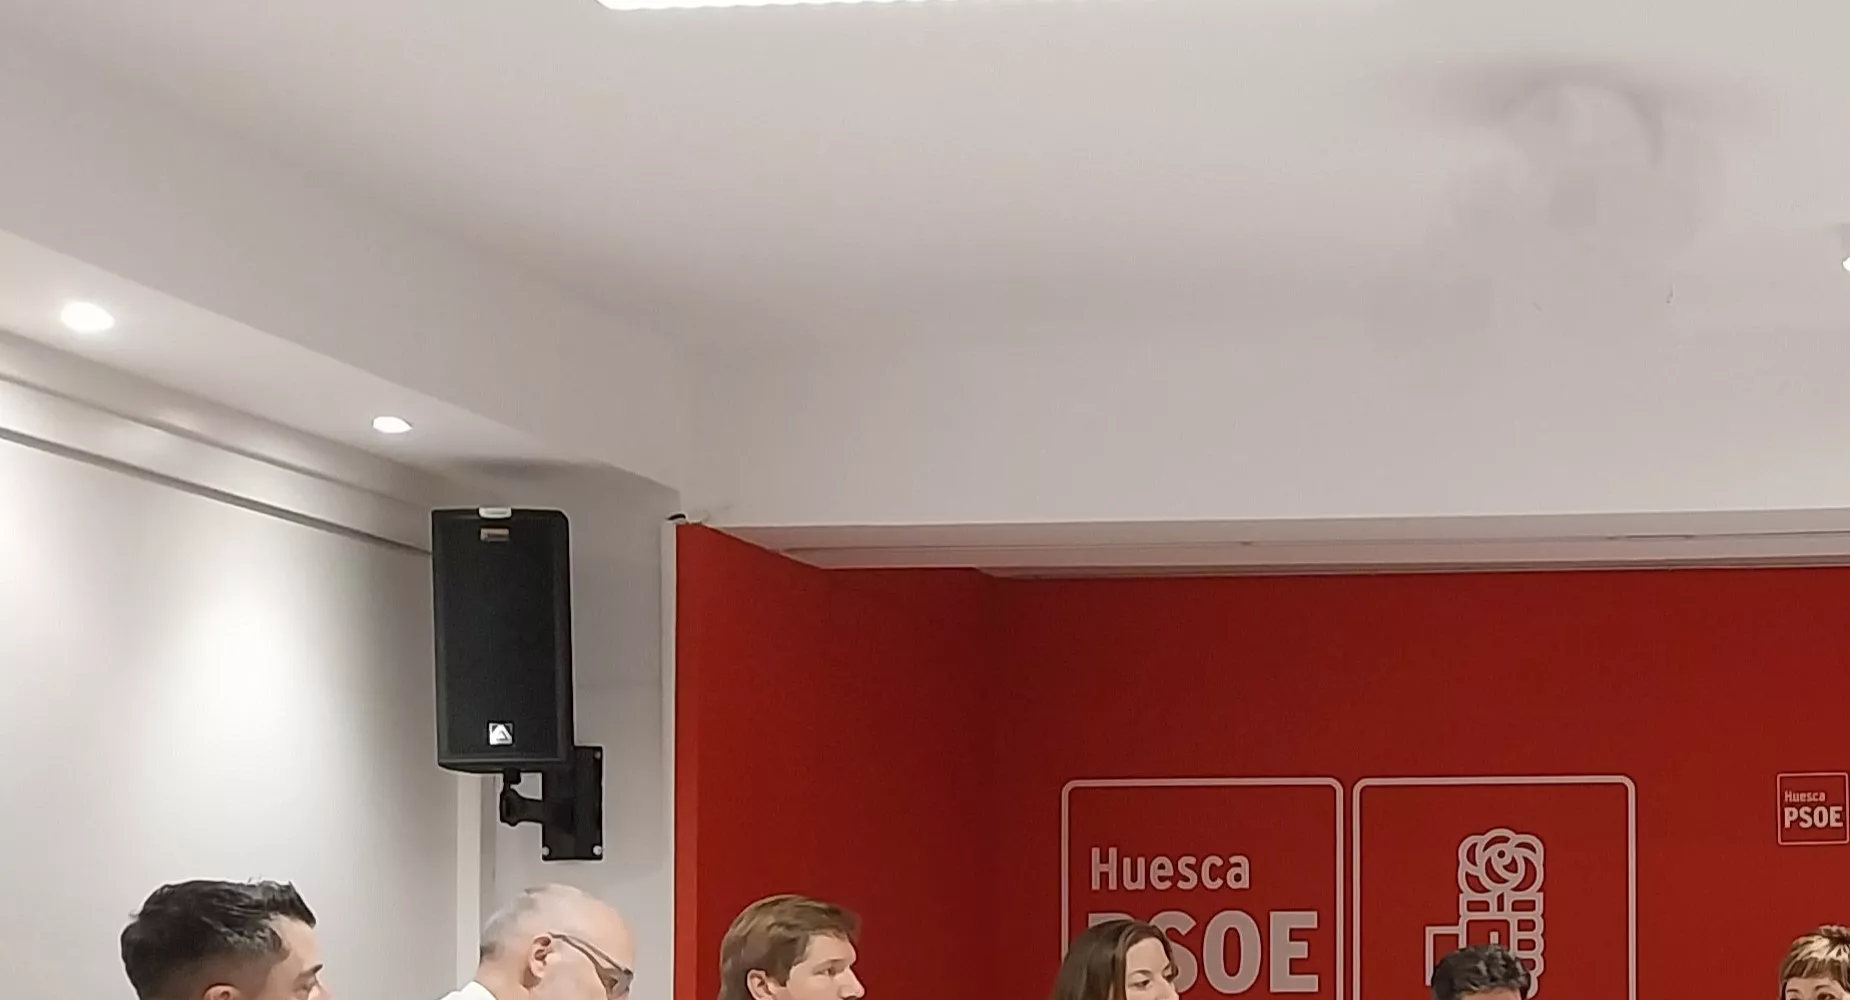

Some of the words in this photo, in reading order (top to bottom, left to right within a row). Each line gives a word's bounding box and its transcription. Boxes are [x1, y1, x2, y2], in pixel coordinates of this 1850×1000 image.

[1784, 790, 1826, 803] Huesca
[1784, 805, 1844, 829] PSOE
[1091, 847, 1250, 890] Huesca
[1087, 910, 1319, 994] SOE
